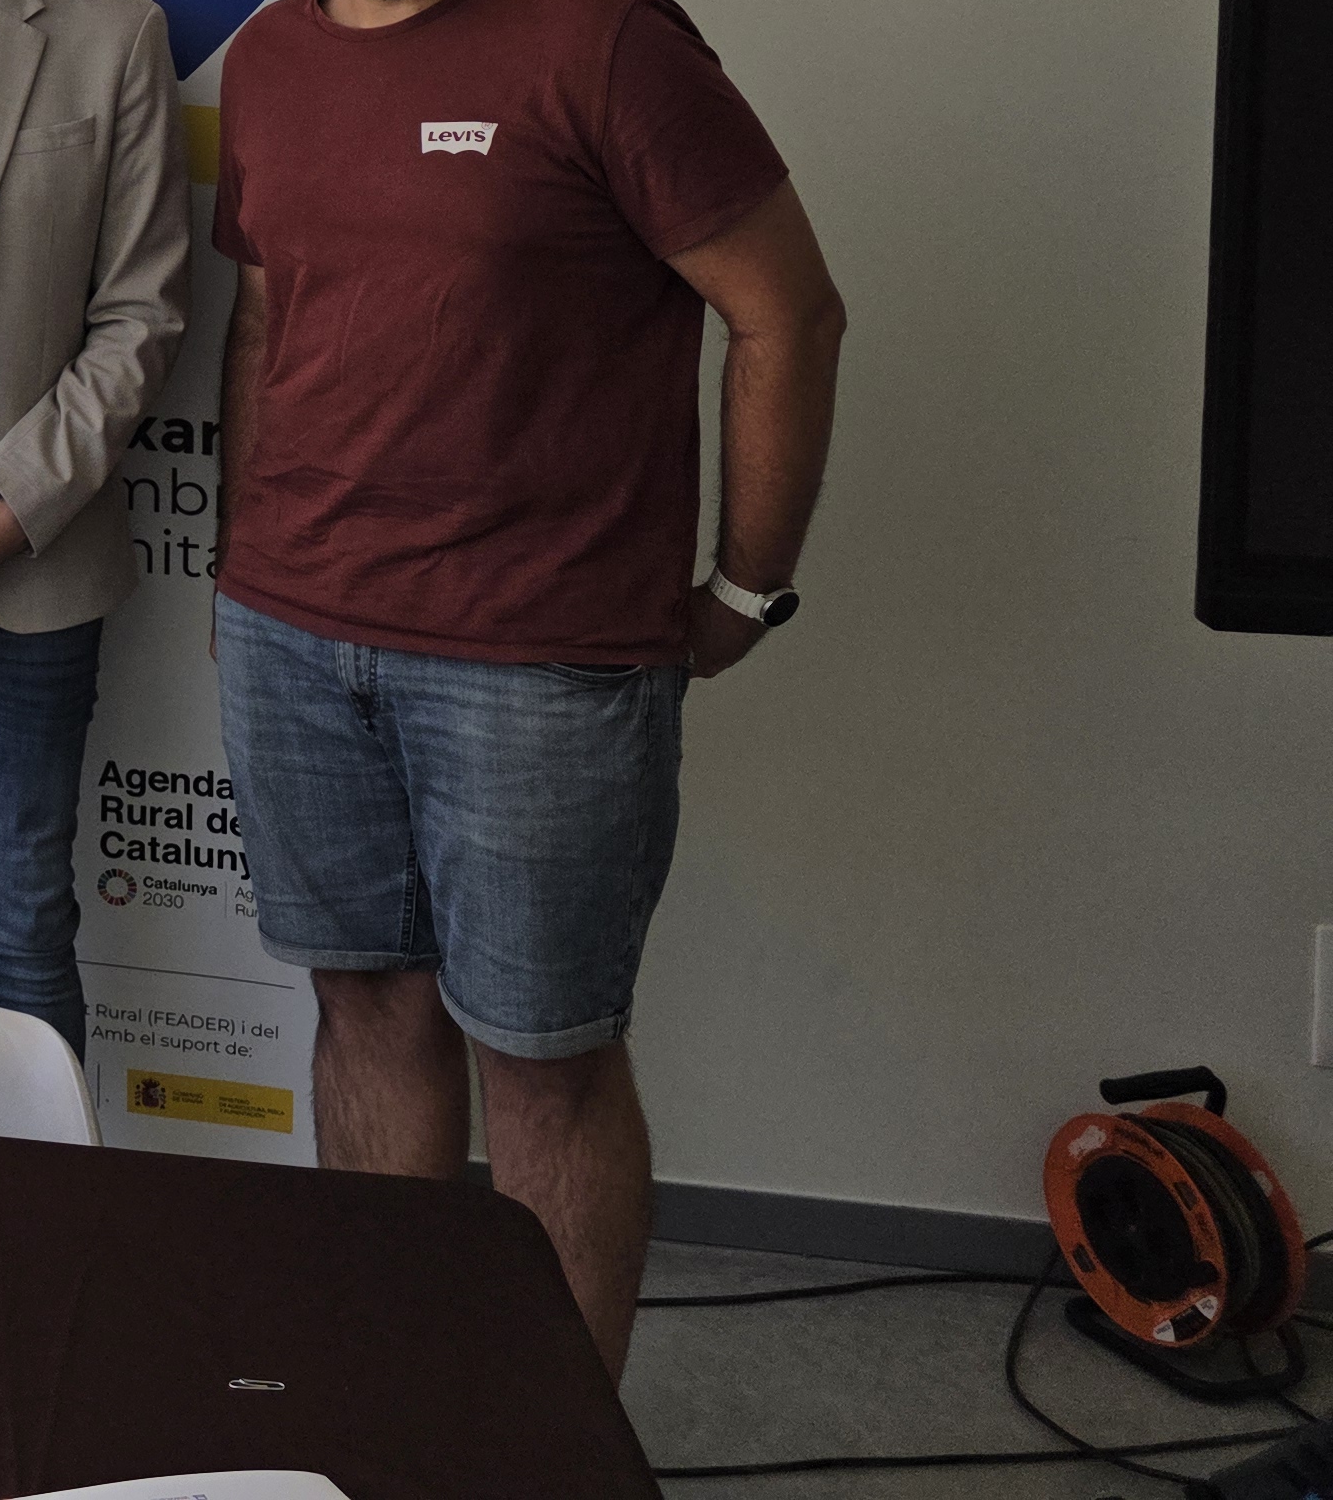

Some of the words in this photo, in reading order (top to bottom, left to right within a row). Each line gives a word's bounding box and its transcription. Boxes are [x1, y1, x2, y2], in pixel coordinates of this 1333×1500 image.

[98, 760, 235, 800] Agenda
[100, 794, 193, 830] Rural
[142, 891, 185, 910] 2030
[143, 876, 218, 897] Catalunya
[96, 1003, 143, 1023] Rural
[148, 1009, 236, 1036] (FEADER)
[241, 1020, 246, 1035] i
[250, 1023, 279, 1040] del
[91, 1025, 135, 1043] Amb
[140, 1031, 156, 1047] el
[160, 1035, 220, 1053] suport
[225, 1041, 253, 1058] de:
